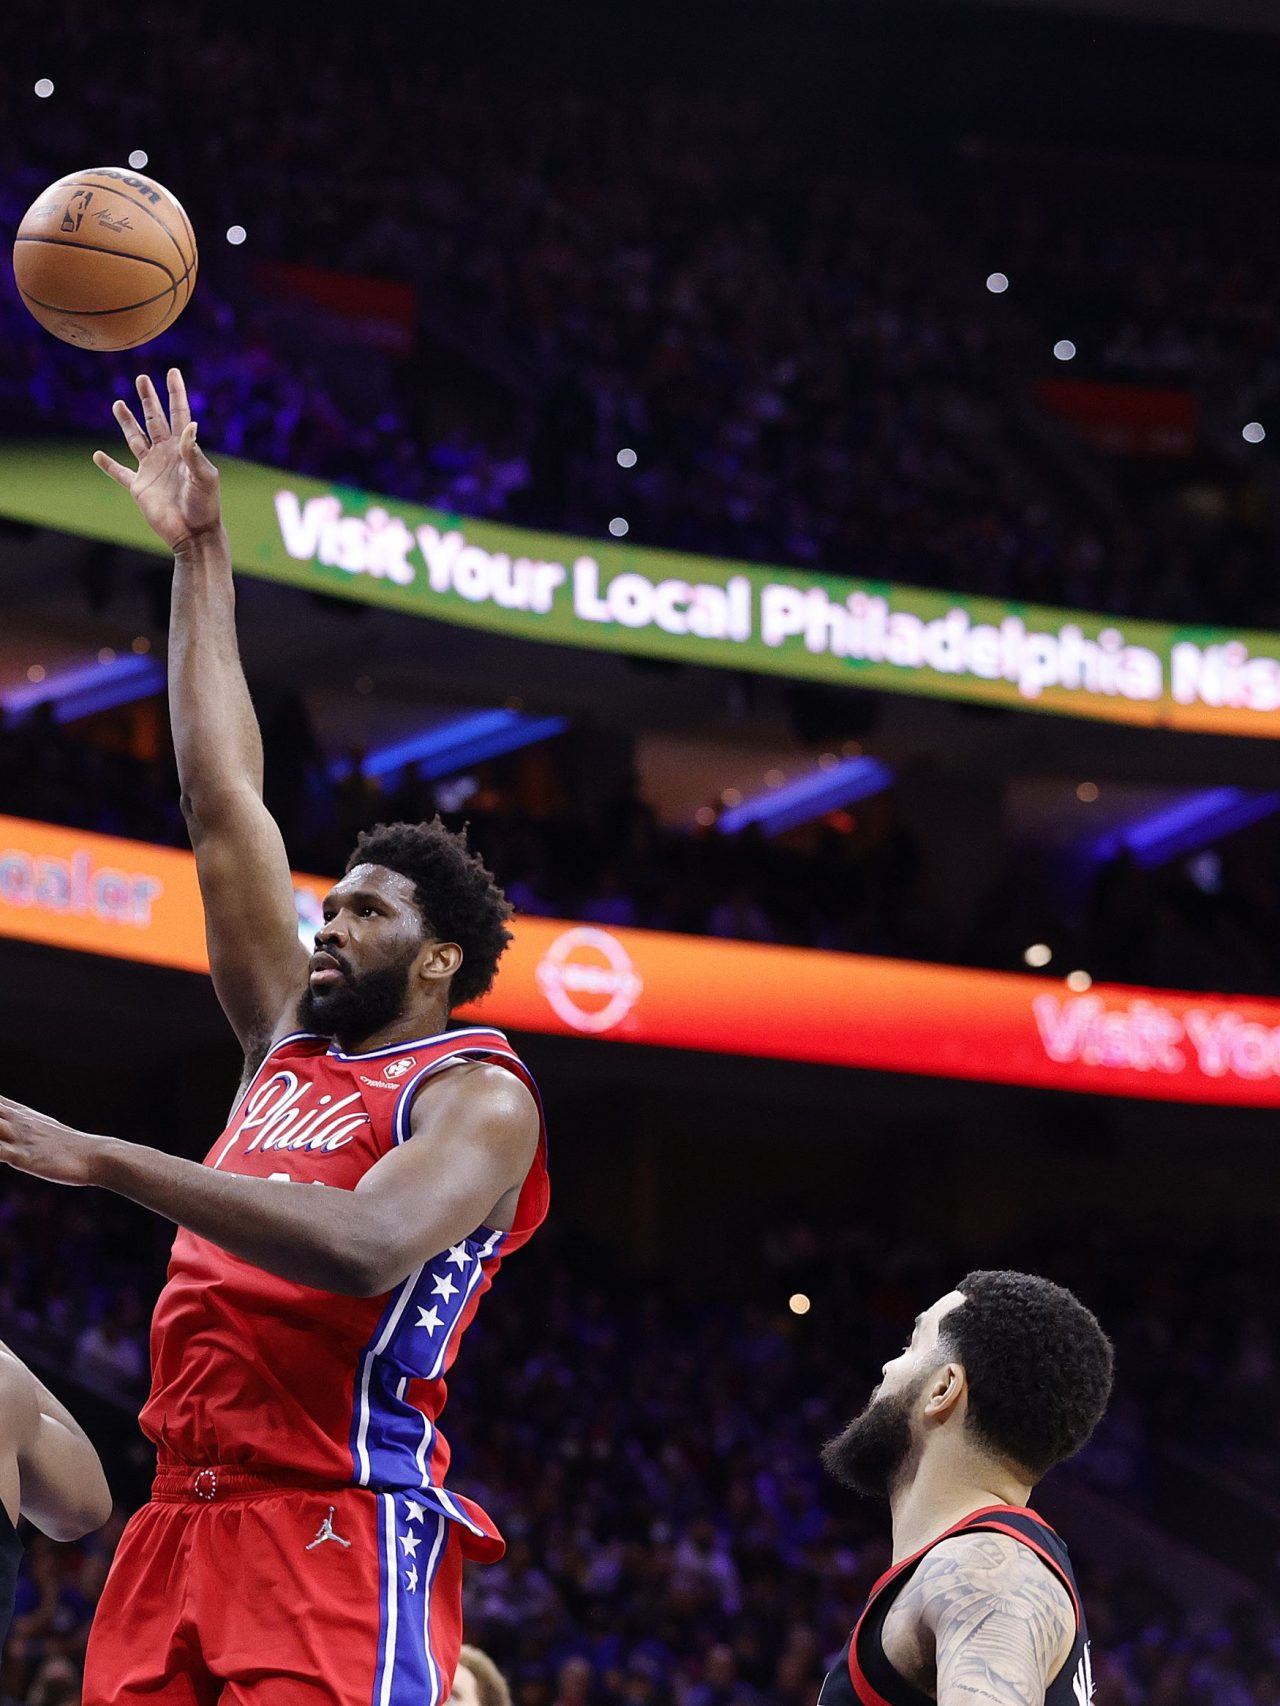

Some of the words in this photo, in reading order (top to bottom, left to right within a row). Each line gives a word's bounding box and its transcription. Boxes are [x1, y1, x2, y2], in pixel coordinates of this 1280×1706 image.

[275, 489, 416, 586] Visit
[416, 523, 567, 615] Your
[573, 556, 752, 642] Local
[761, 583, 1163, 700] Philadelphia
[1032, 993, 1186, 1074] Visit
[213, 1070, 371, 1169] Phila
